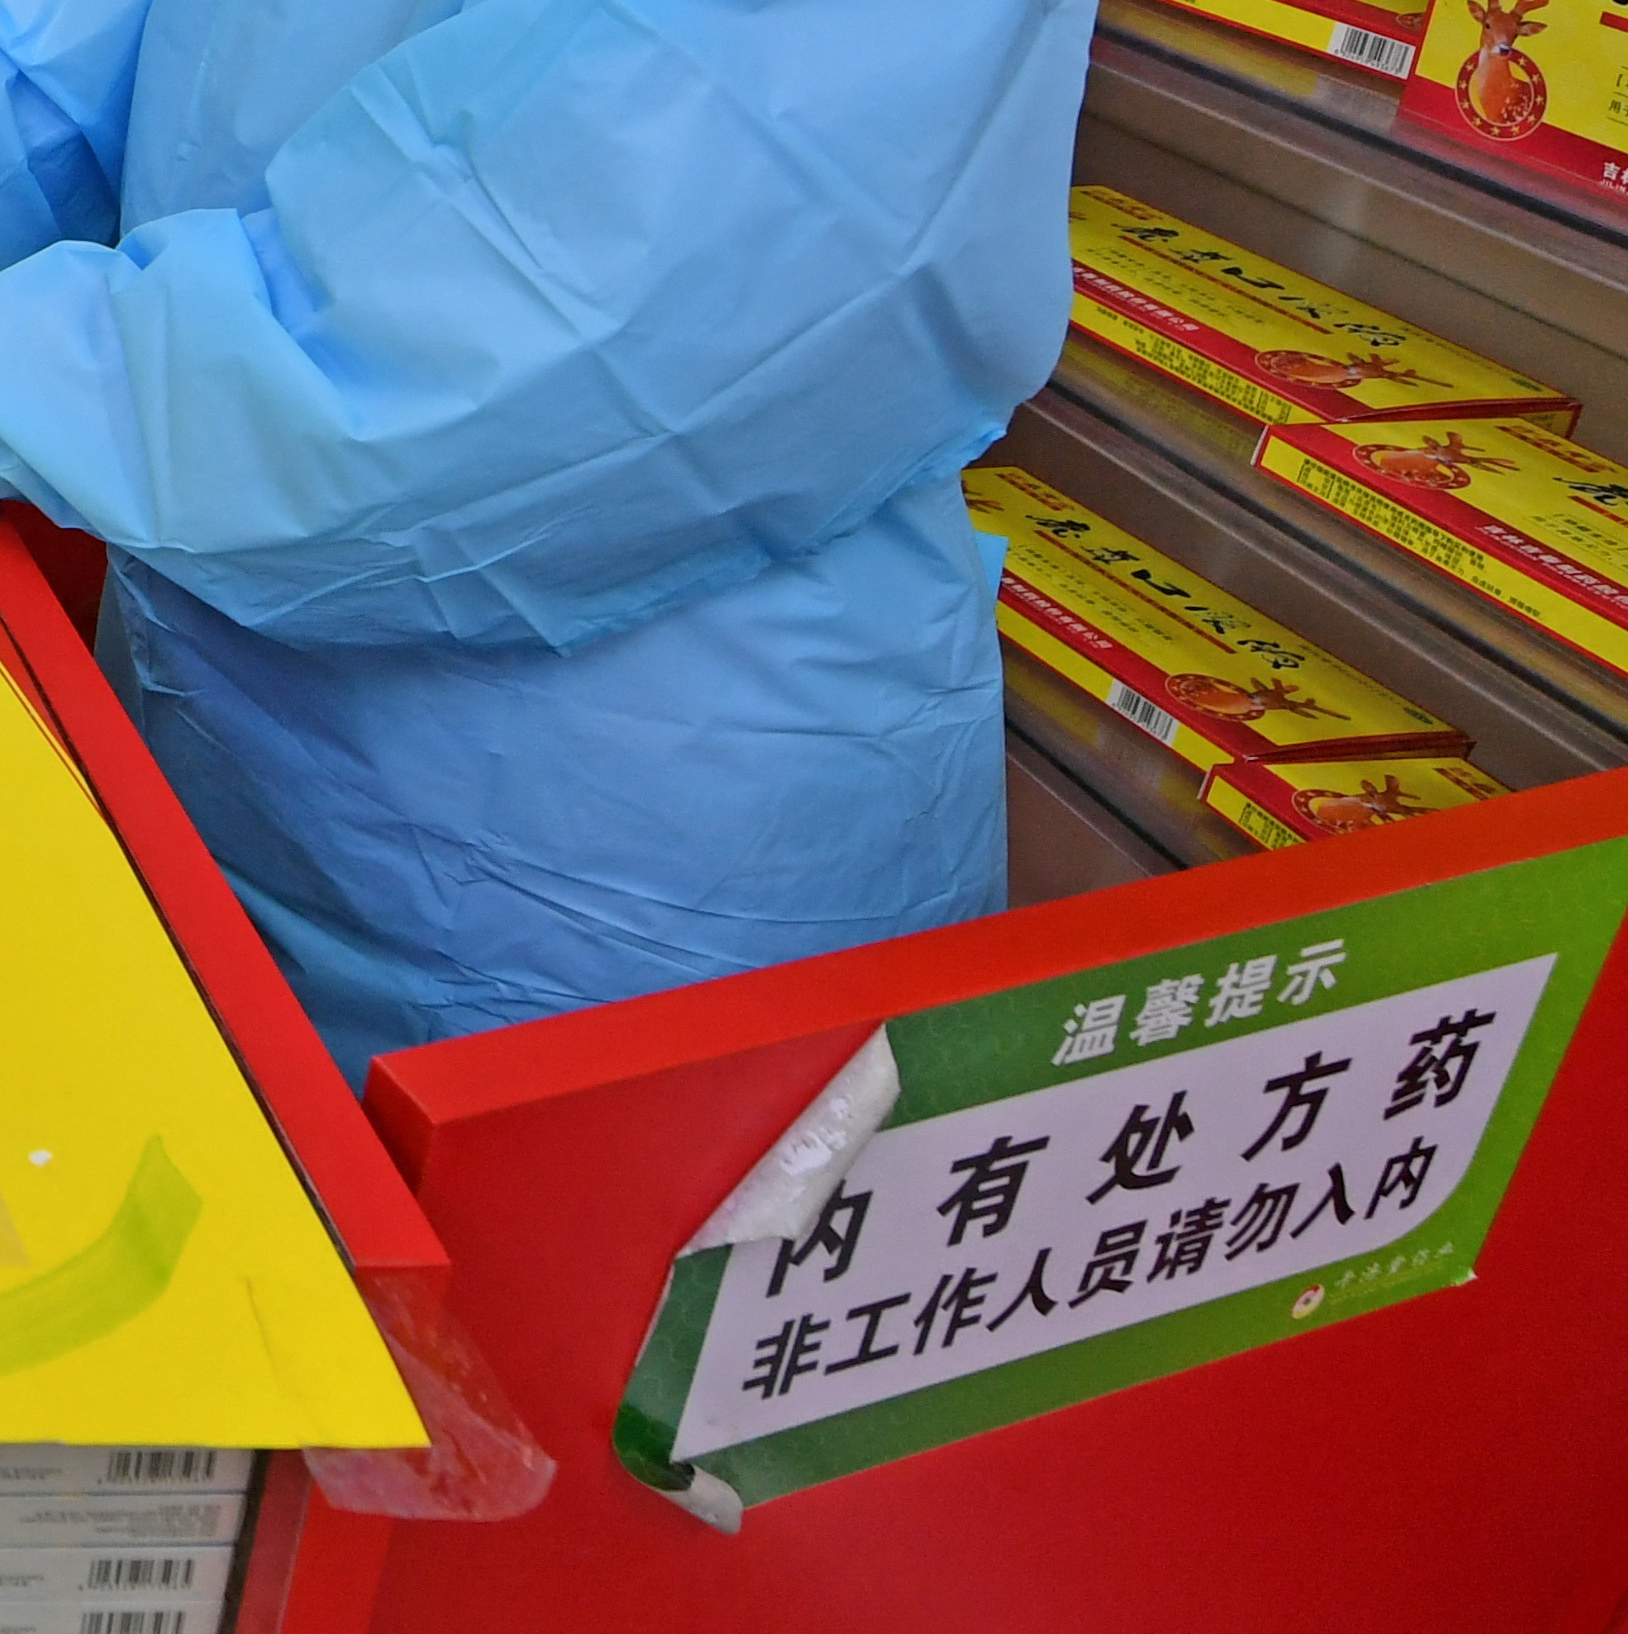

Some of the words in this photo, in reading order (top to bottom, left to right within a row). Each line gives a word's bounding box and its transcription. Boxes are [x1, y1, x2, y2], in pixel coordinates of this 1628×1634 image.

[1049, 939, 1345, 1068] 温馨提示
[742, 1137, 1436, 1400] 非工作人员请勿入内
[765, 1008, 1498, 1298] 内有处方药
